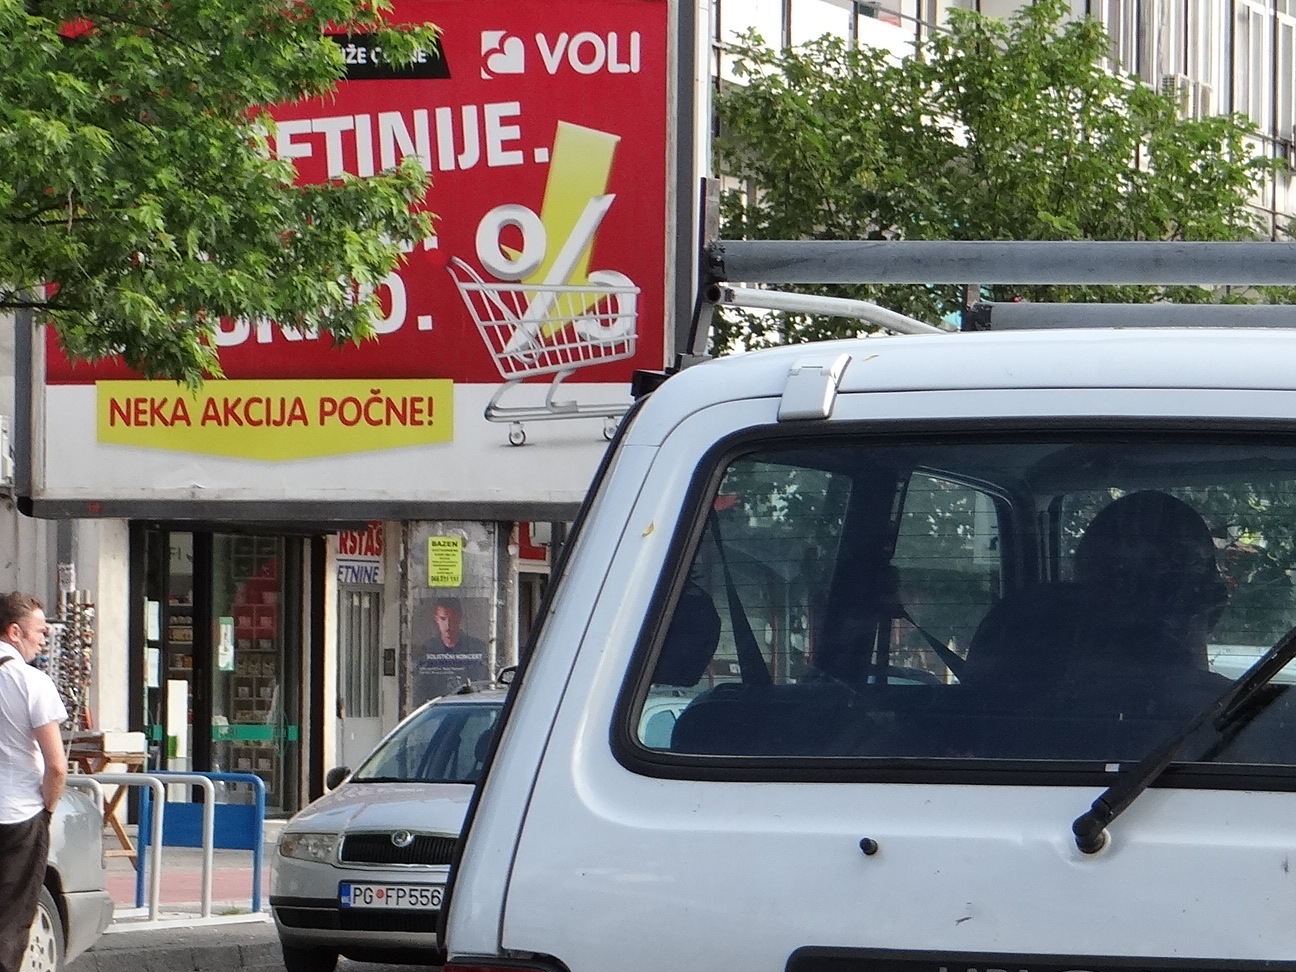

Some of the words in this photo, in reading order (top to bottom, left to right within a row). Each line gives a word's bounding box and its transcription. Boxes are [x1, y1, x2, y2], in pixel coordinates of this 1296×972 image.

[535, 31, 641, 75] VOLI
[109, 396, 192, 427] NEKA
[201, 396, 310, 427] AKCIJA
[319, 388, 434, 427] POČNE!
[431, 540, 459, 548] BAZEN
[353, 887, 374, 905] PG
[385, 888, 441, 906] FP556
